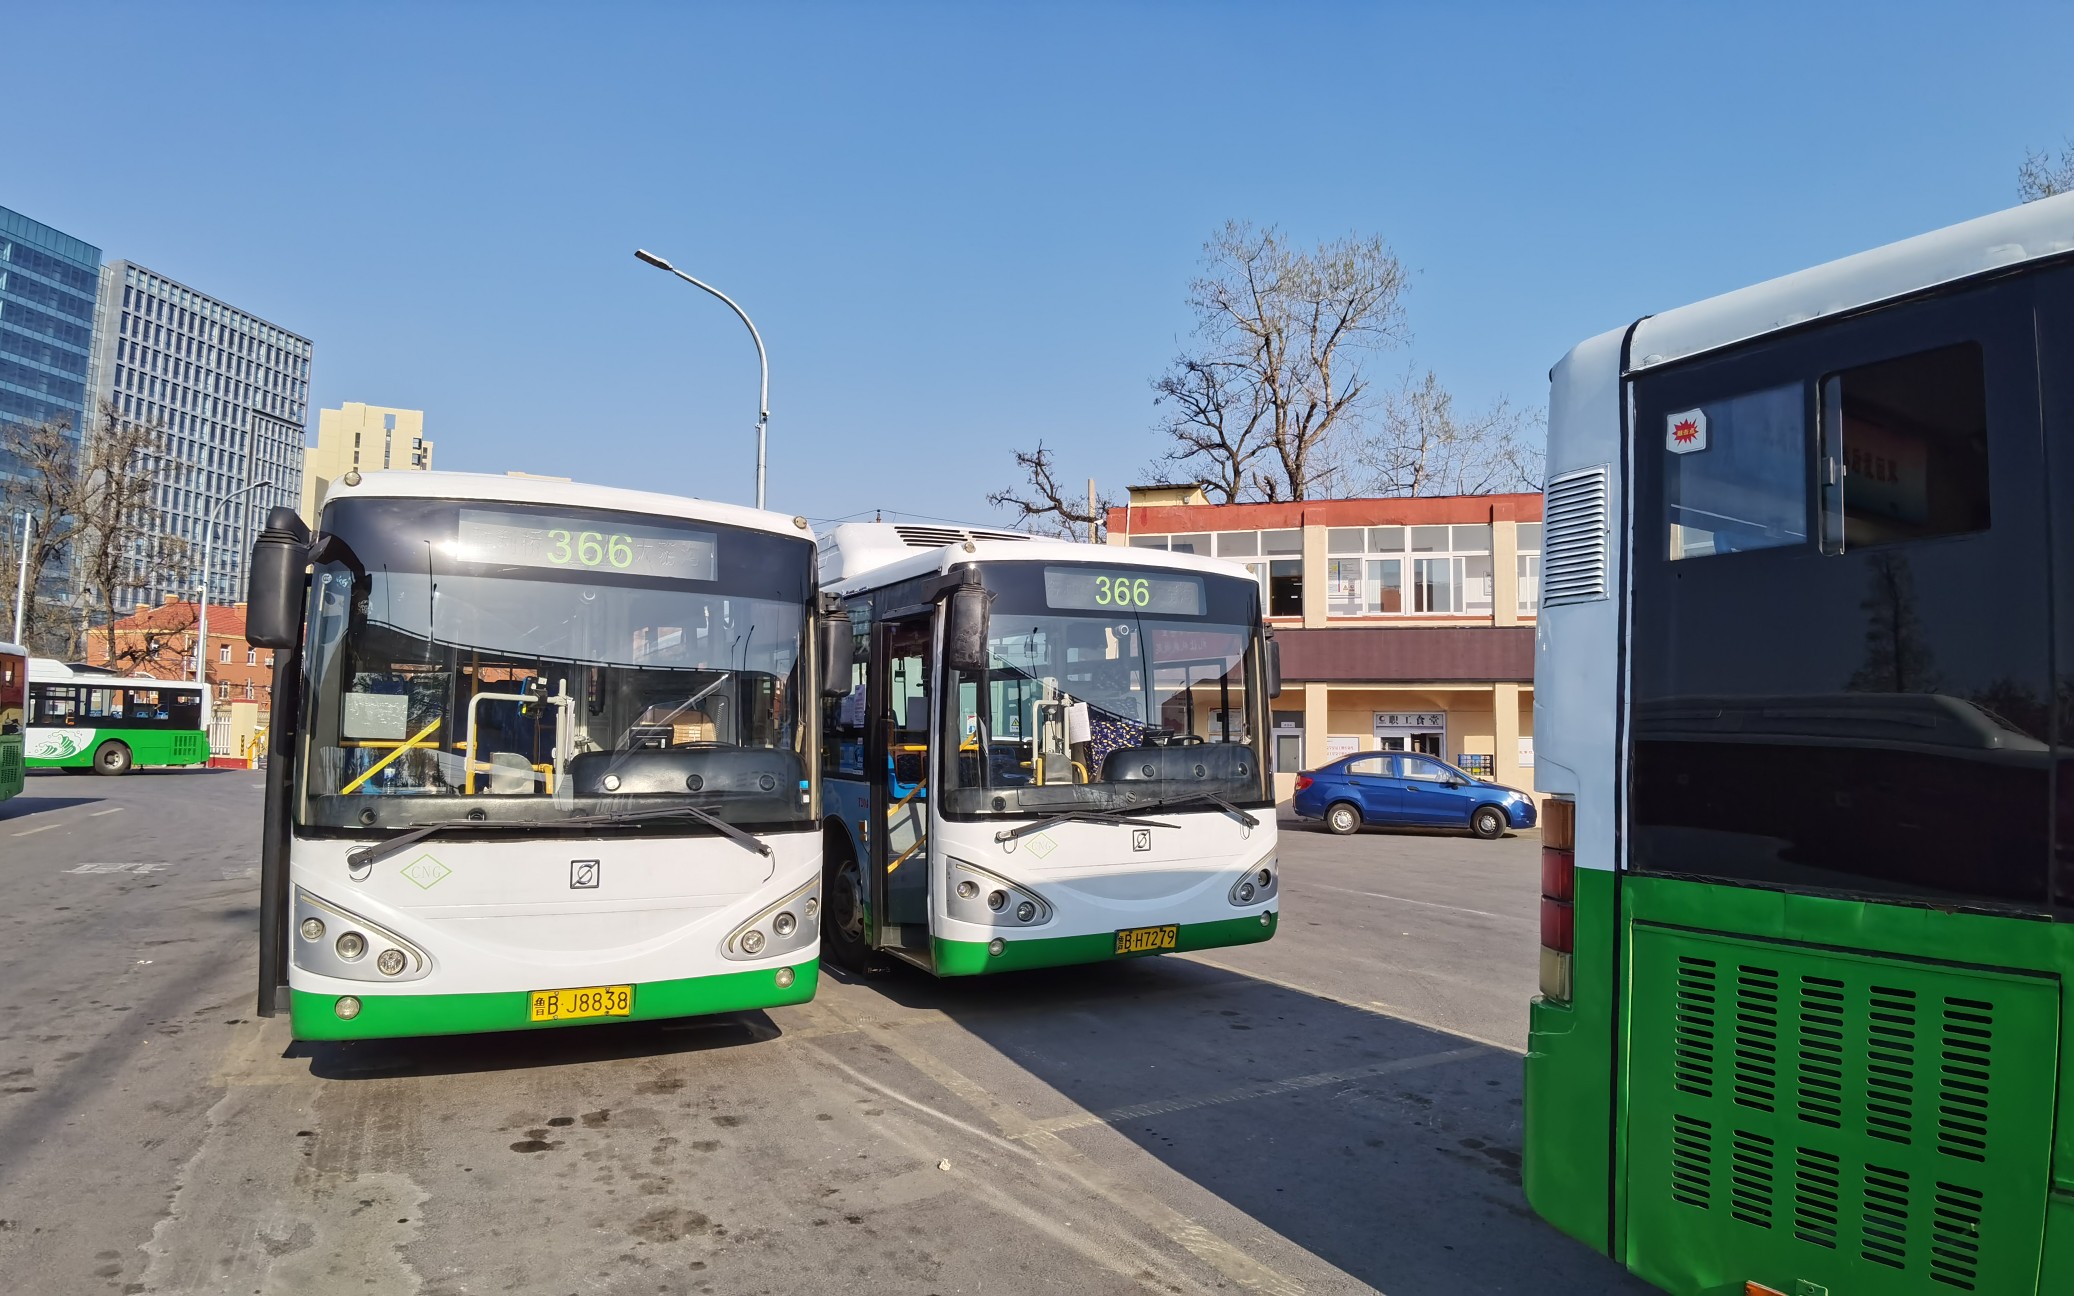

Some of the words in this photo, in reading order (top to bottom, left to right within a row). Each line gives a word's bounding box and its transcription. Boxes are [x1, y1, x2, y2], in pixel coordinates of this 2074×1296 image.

[547, 528, 633, 568] 366
[1095, 576, 1150, 607] 366
[1388, 714, 1440, 726] 职工食堂
[411, 865, 441, 879] CNG
